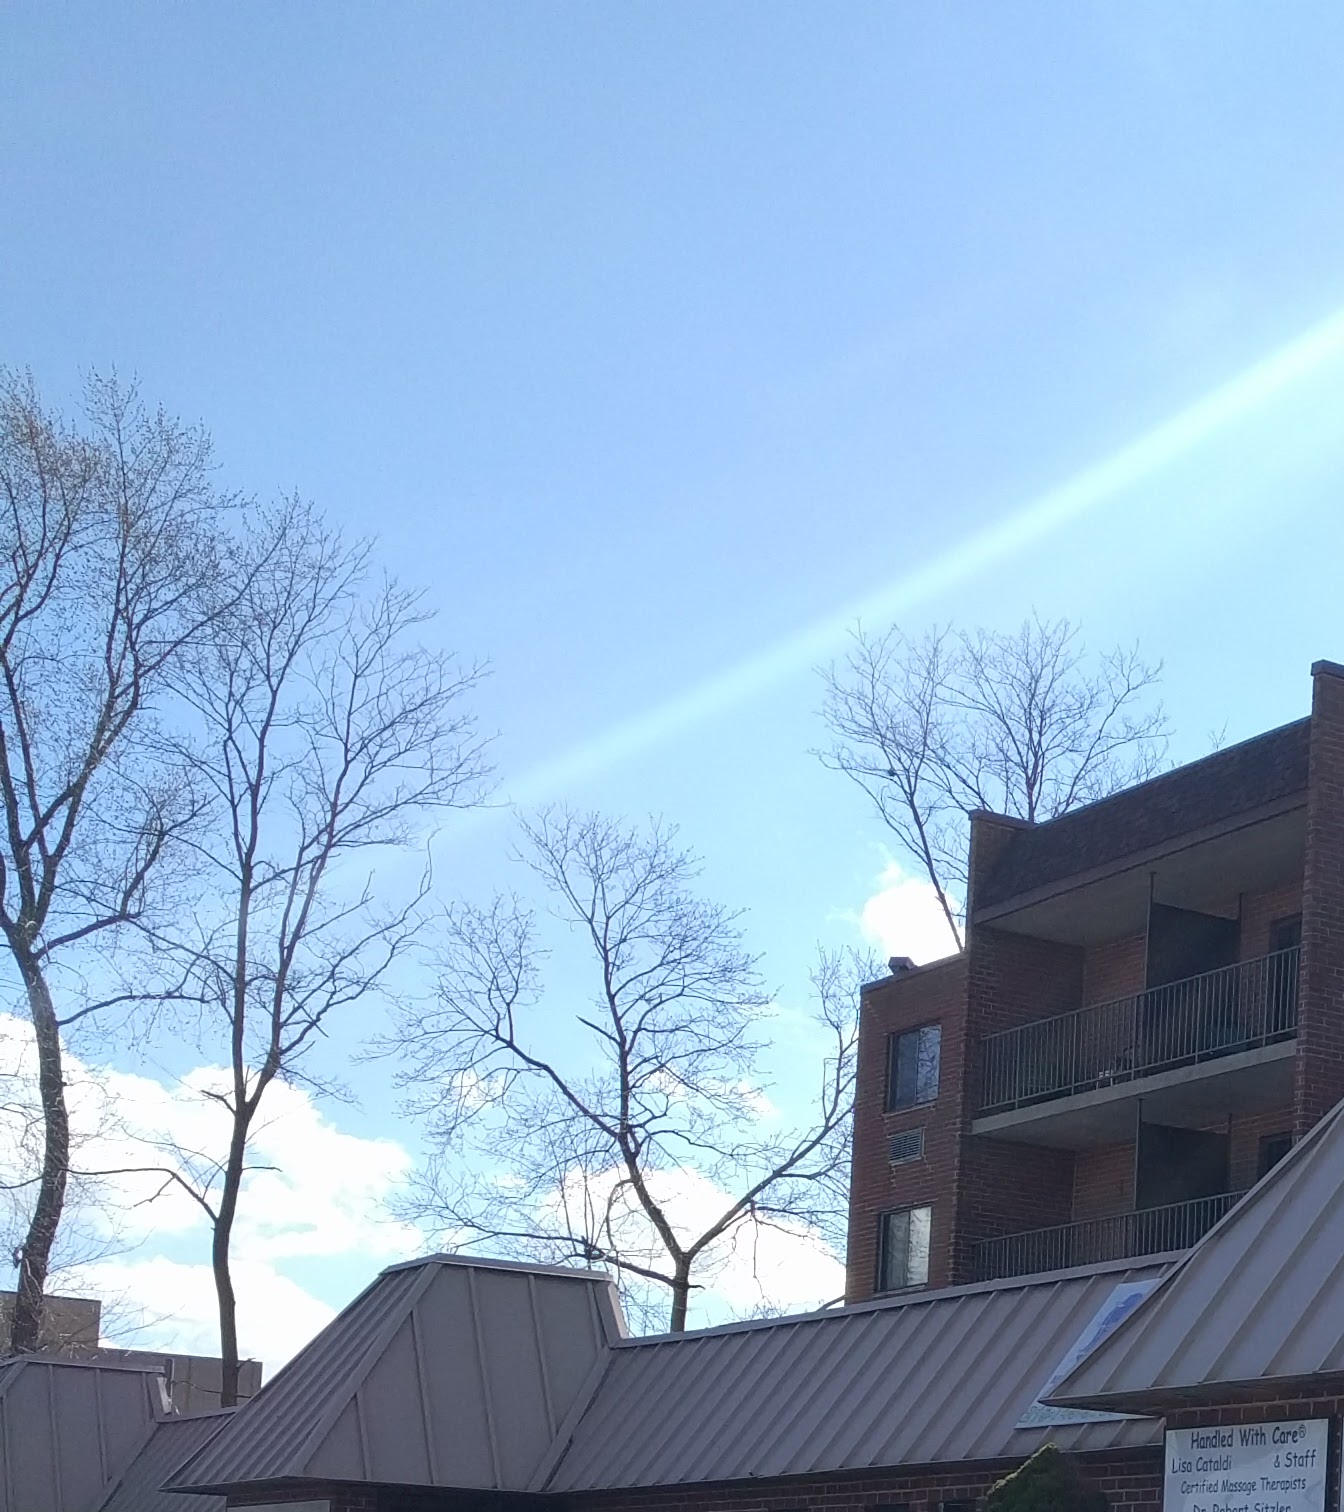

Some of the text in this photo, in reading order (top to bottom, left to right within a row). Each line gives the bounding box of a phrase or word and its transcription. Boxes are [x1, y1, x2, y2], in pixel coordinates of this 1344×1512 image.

[1190, 1426, 1234, 1450] Handled
[1239, 1427, 1266, 1447] With
[1172, 1448, 1317, 1474] Lisa Cataldi & Staff
[1180, 1475, 1307, 1495] Certified Massage Therapists
